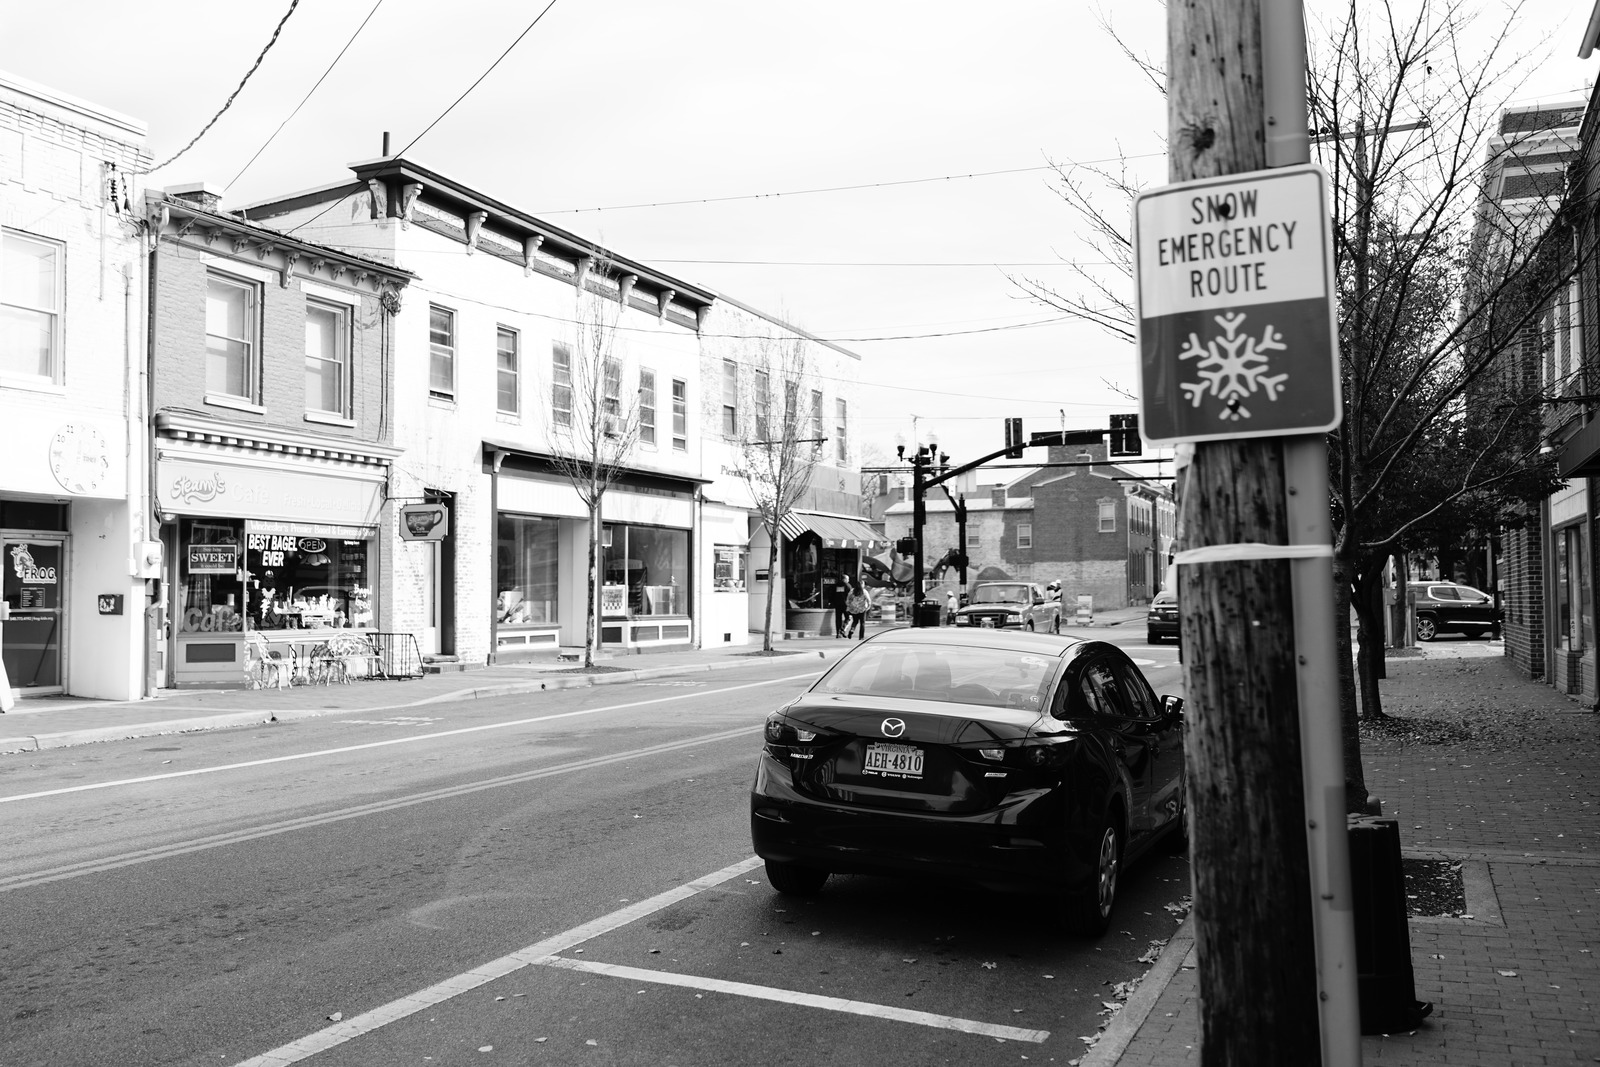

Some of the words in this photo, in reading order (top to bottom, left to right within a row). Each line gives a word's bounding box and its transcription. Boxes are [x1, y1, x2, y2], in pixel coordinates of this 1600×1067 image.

[1191, 189, 1258, 225] SNOW
[1158, 220, 1297, 267] EMERGENCY
[1190, 262, 1267, 298] ROUTE
[169, 472, 226, 506] Steamy's
[248, 534, 271, 550] BEST
[271, 535, 298, 552] BAGEL
[300, 541, 324, 550] OPEN
[191, 553, 234, 563] SWEET
[262, 550, 285, 567] EVER
[865, 752, 922, 771] AEH-4810
